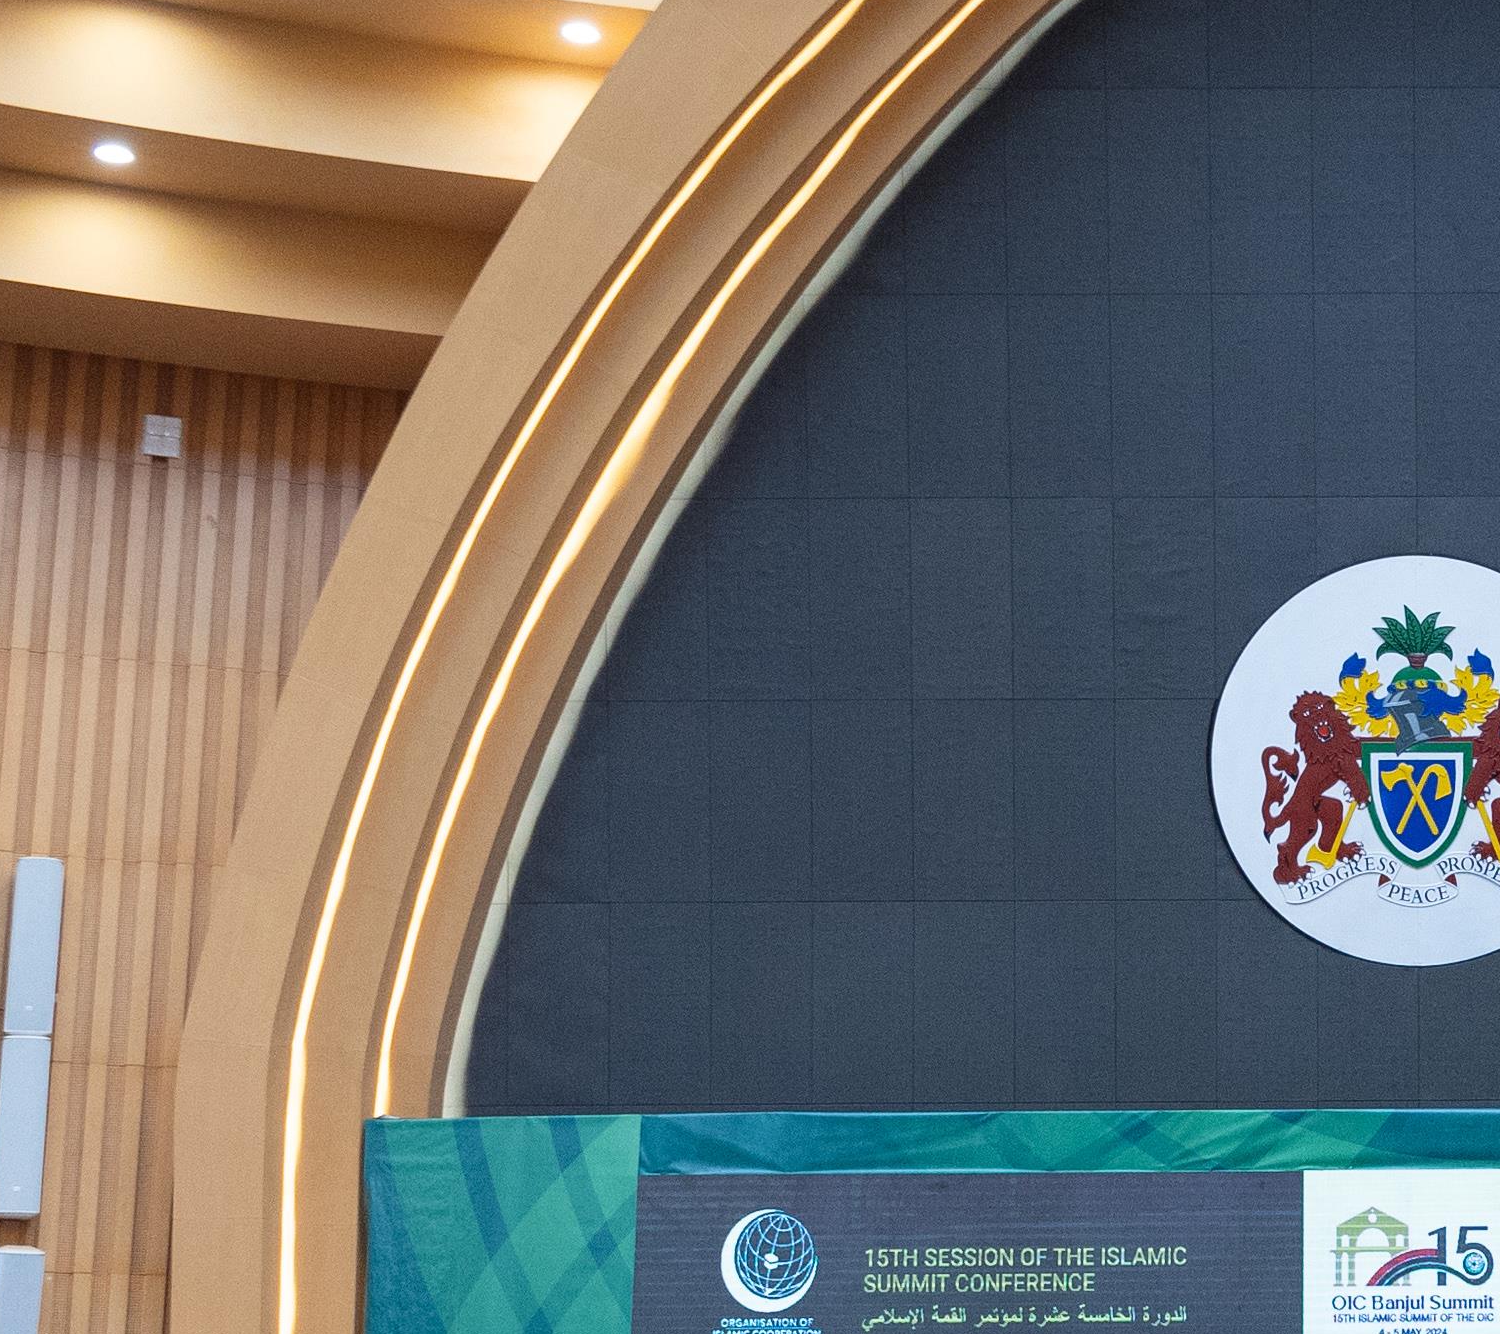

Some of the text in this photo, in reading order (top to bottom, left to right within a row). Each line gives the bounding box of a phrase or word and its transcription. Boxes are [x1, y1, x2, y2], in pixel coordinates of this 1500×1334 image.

[1297, 857, 1398, 900] PROGRESS
[1388, 884, 1449, 904] PEACE
[865, 1246, 1187, 1267] 15TH SESSION OF THE ISLAMIC
[1428, 1226, 1494, 1286] 15
[864, 1273, 1095, 1293] SUMMIT CONFERENCE
[931, 1304, 966, 1323] القمة
[1077, 1303, 1136, 1323] الخامسة
[1332, 1295, 1494, 1312] OIC Banjul Summit
[720, 1317, 814, 1327] ORGANISATION OF
[861, 1307, 924, 1332] الإسلامي
[1028, 1306, 1071, 1328] عشرة
[1142, 1305, 1187, 1327] الدورة
[1333, 1314, 1356, 1323] 15TH
[1358, 1313, 1397, 1323] ISLAMIC
[1399, 1313, 1437, 1323] SUMMIT
[1440, 1313, 1453, 1322] OF
[1456, 1313, 1475, 1322] THE
